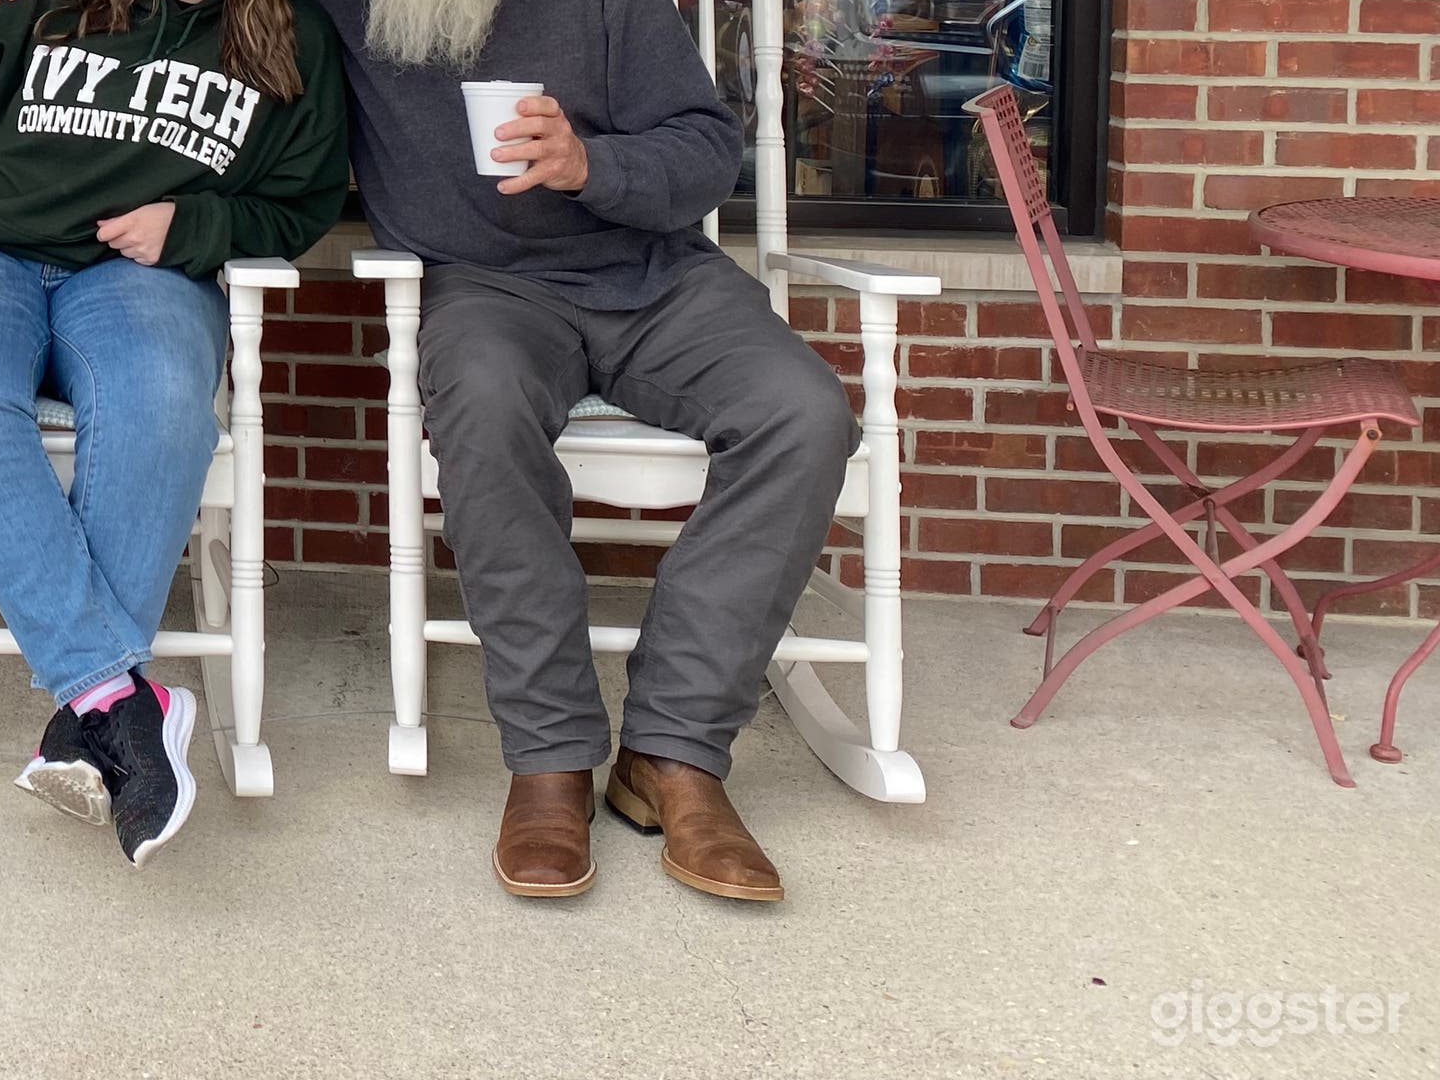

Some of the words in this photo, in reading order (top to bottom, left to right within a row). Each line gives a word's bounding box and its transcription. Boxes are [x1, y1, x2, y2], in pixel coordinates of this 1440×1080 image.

[17, 104, 149, 143] COMMUNITY
[147, 118, 236, 176] COLLEGE
[22, 44, 120, 104] IVY
[128, 58, 261, 149] TECH
